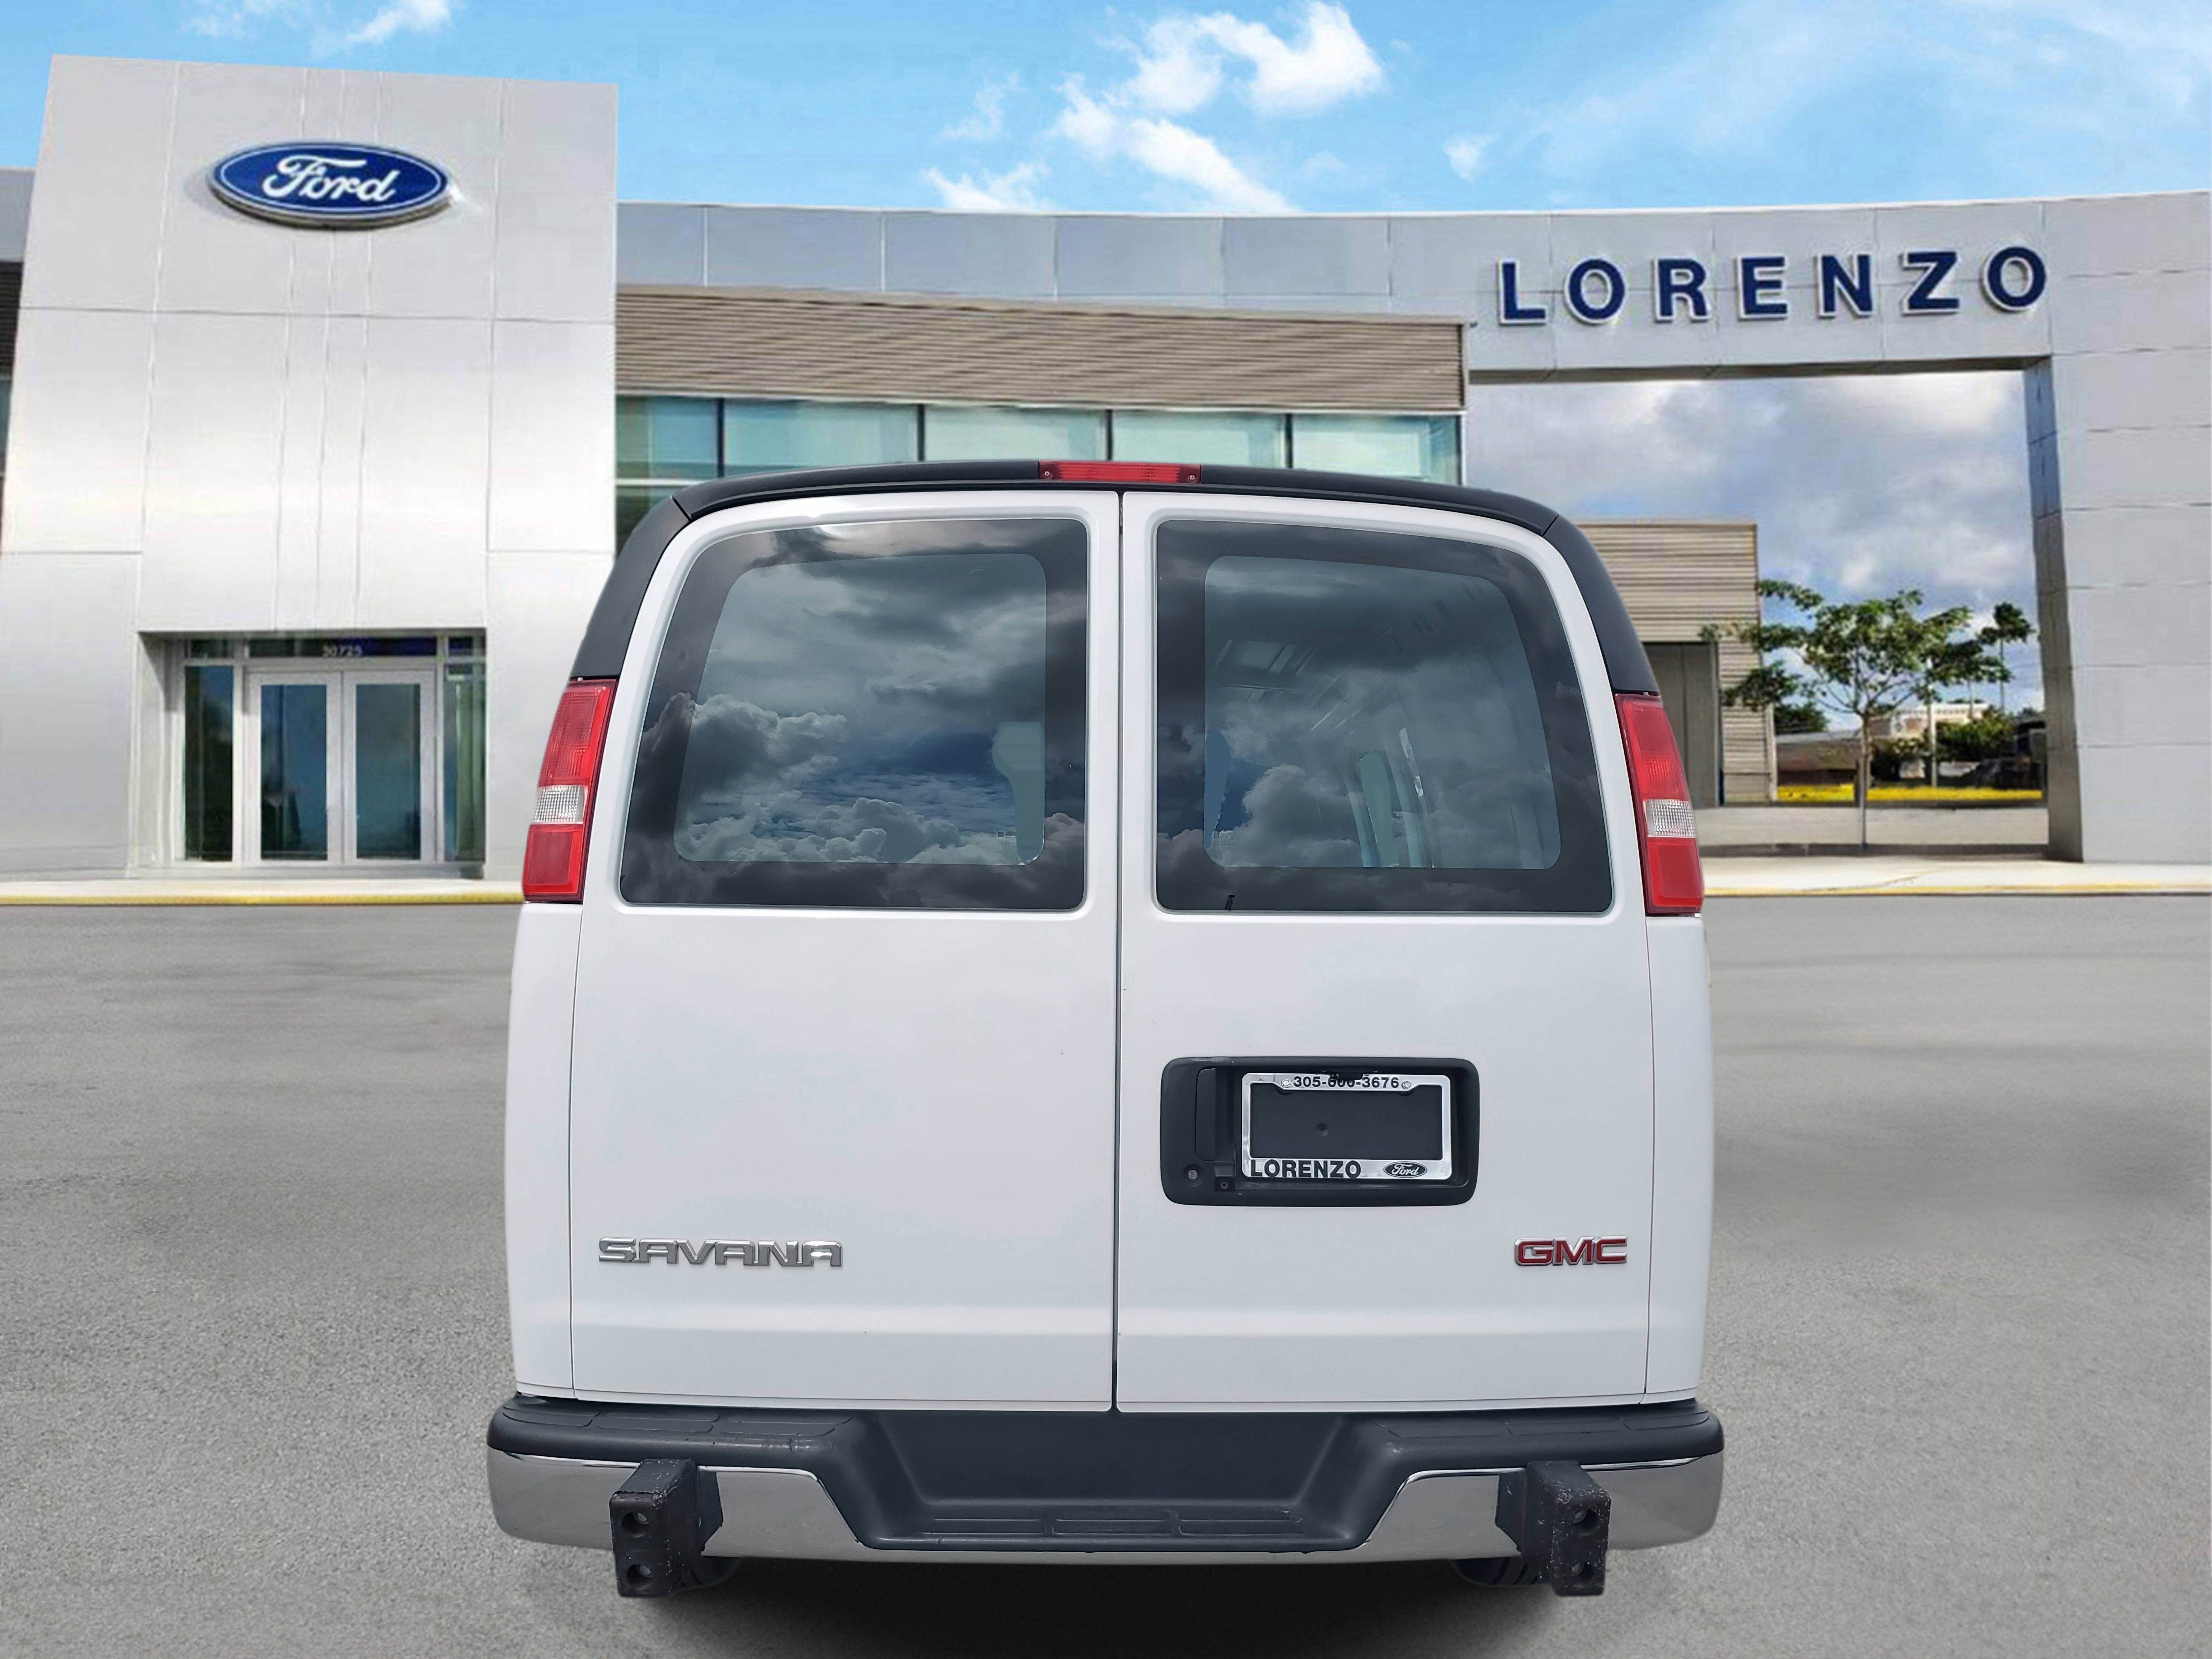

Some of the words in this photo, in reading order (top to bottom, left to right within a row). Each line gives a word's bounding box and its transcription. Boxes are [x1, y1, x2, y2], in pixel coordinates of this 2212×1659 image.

[263, 155, 400, 202] Ford
[1498, 247, 2047, 325] LORENZO
[1250, 1159, 1361, 1178] LORENZO
[1391, 1163, 1419, 1176] Ford
[599, 1237, 843, 1267] SAVANA
[1514, 1235, 1628, 1266] GMC
